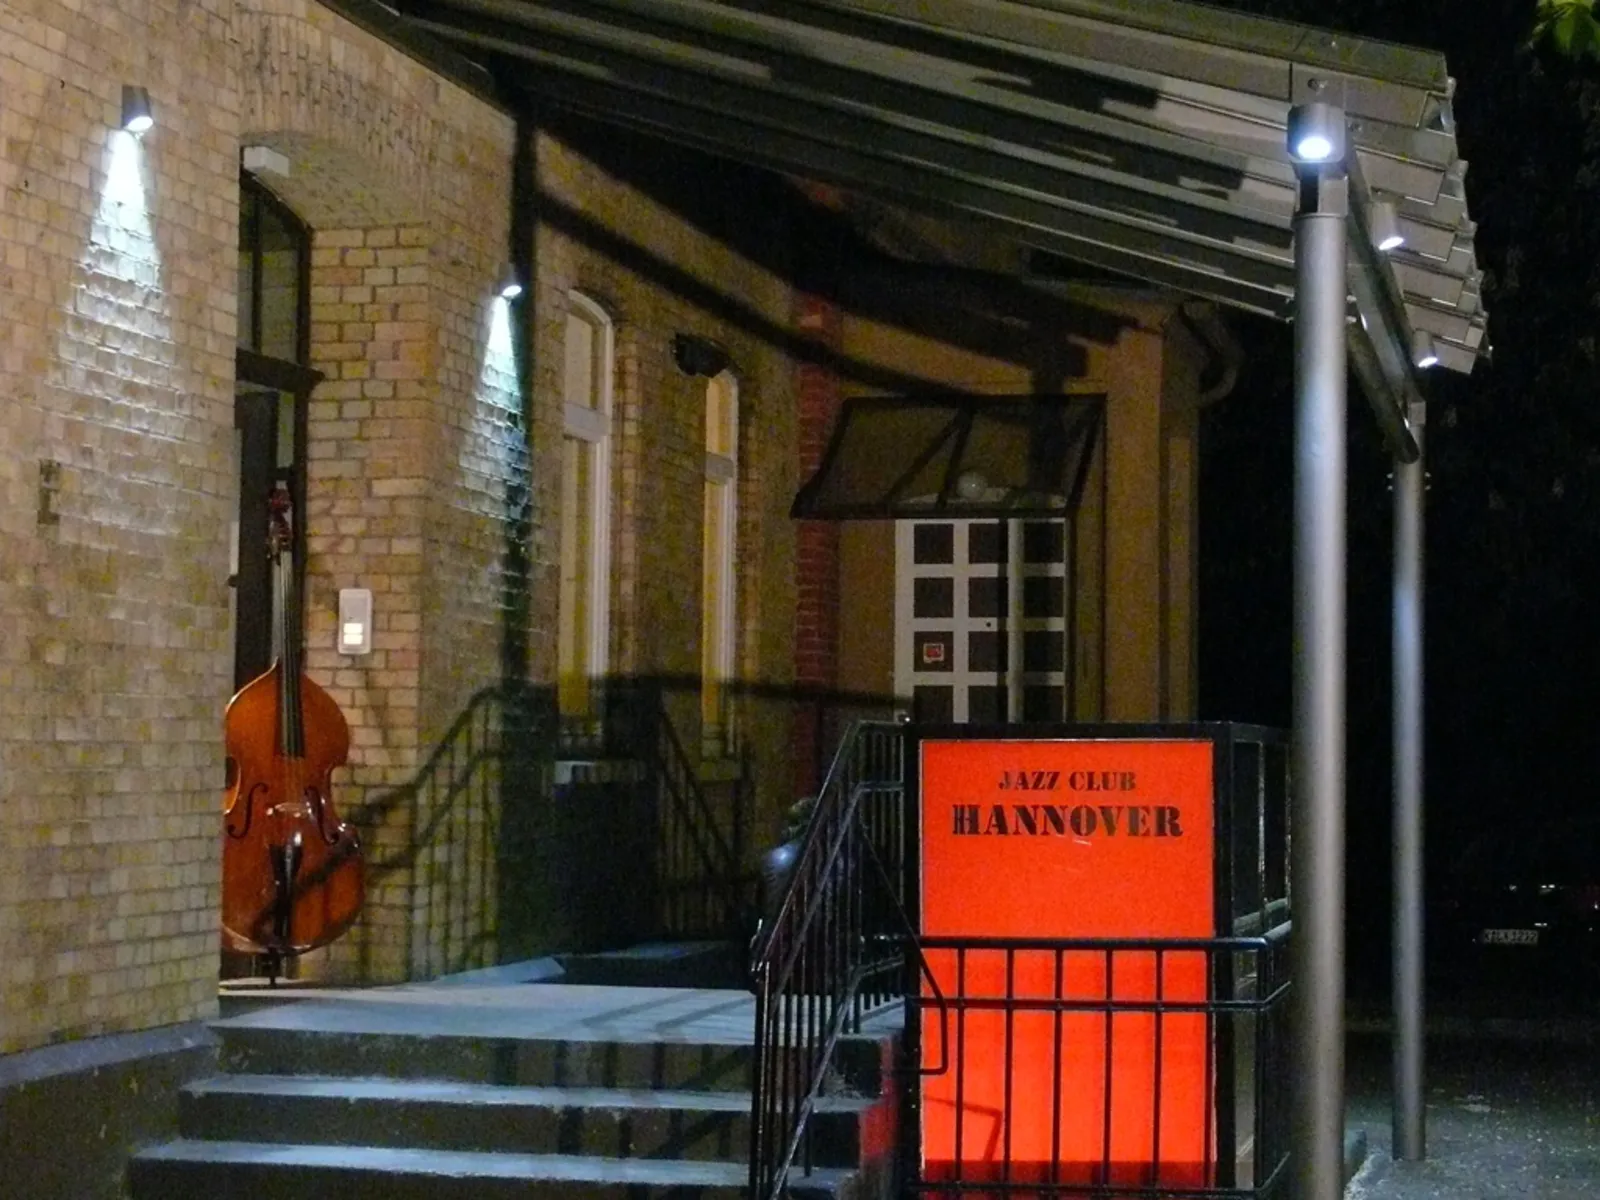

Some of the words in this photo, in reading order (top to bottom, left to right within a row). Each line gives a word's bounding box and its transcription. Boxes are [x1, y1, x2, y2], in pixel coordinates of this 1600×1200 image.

[999, 771, 1060, 791] JAZZ
[1069, 771, 1136, 791] CLUB
[952, 804, 1183, 837] HANNOVER
